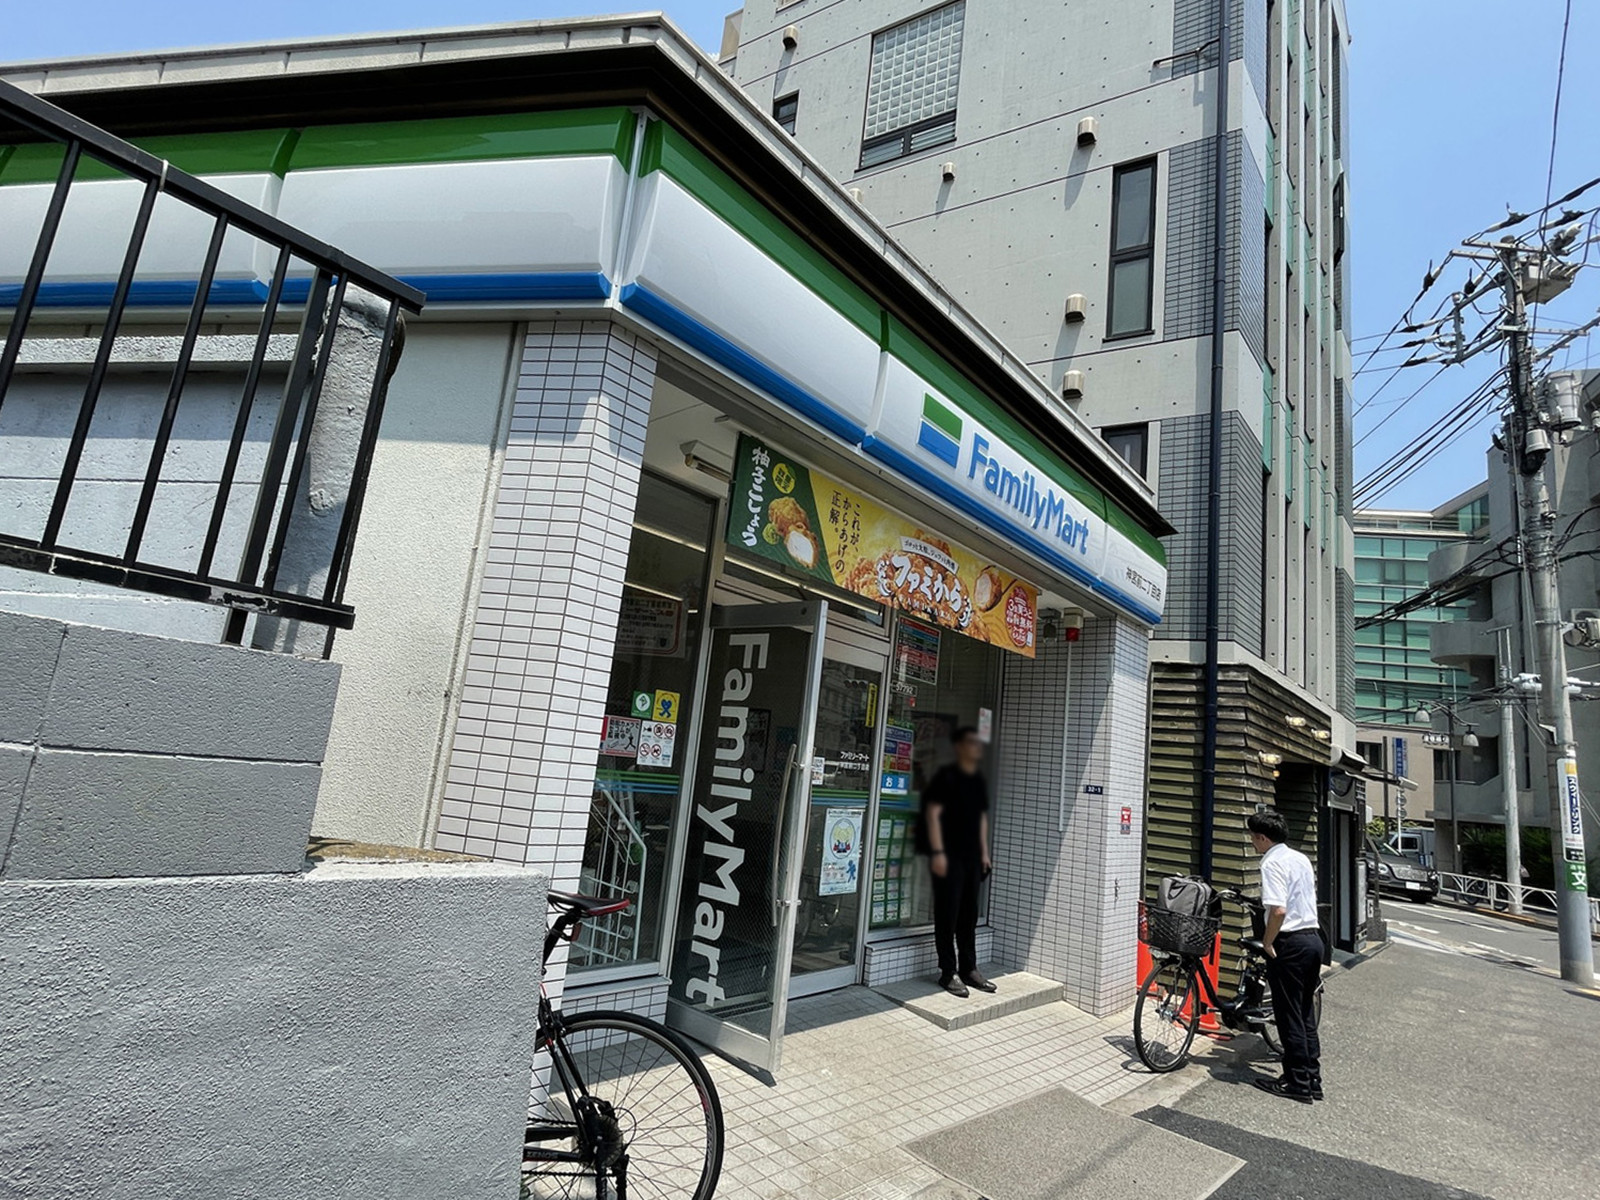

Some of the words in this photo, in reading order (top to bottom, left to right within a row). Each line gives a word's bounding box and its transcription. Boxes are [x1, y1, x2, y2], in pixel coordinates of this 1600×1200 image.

[741, 446, 771, 547] 柚子こしょう
[835, 497, 852, 573] からあげの
[967, 431, 1089, 556] FamilyMart
[891, 555, 963, 612] ファミから
[685, 632, 770, 1008] FamilyMart
